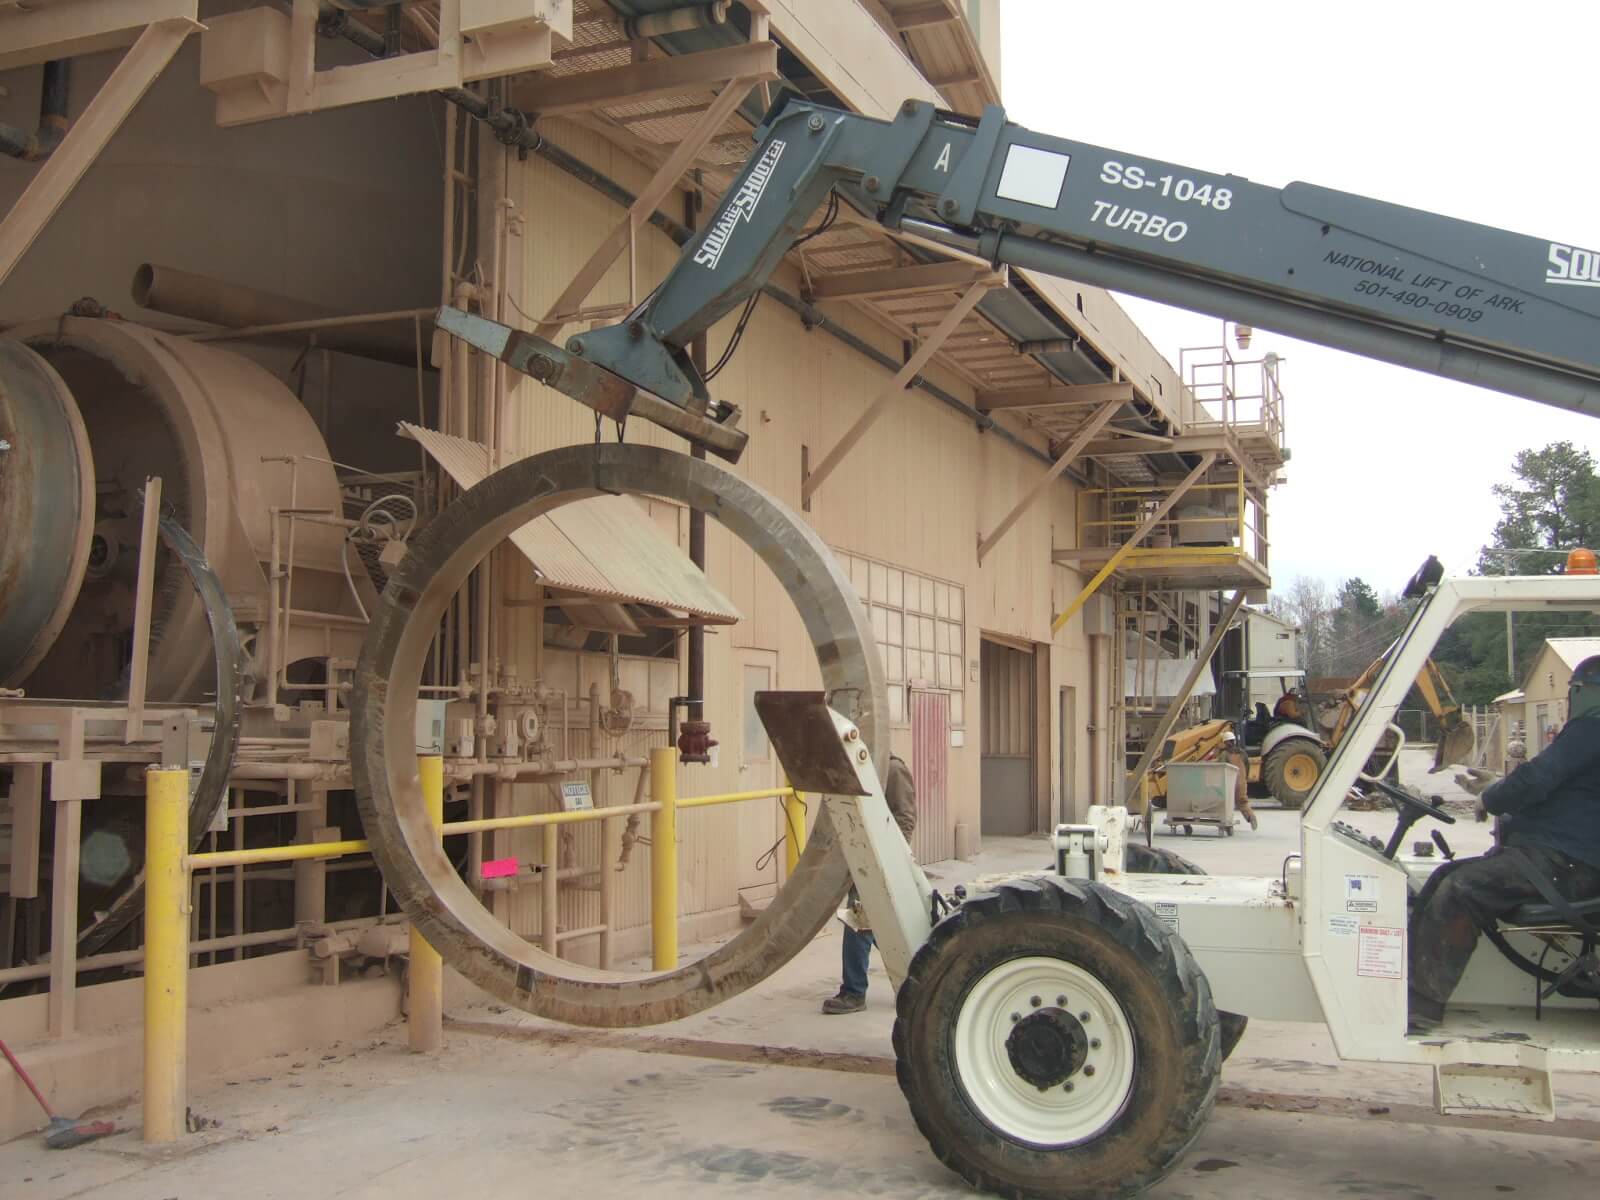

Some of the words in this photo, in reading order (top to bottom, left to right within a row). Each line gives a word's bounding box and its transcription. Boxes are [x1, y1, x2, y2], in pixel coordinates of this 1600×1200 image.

[933, 143, 951, 172] A
[694, 202, 741, 268] SQUARE
[733, 139, 784, 212] SHOOTER
[1100, 161, 1233, 210] SS-1048
[1090, 200, 1188, 242] TURBO
[1323, 250, 1405, 282] NATIONAL
[1411, 273, 1453, 292] LIFT
[1454, 285, 1484, 300] OF
[1484, 294, 1526, 314] ARK.
[1354, 279, 1484, 323] 501-490-0909
